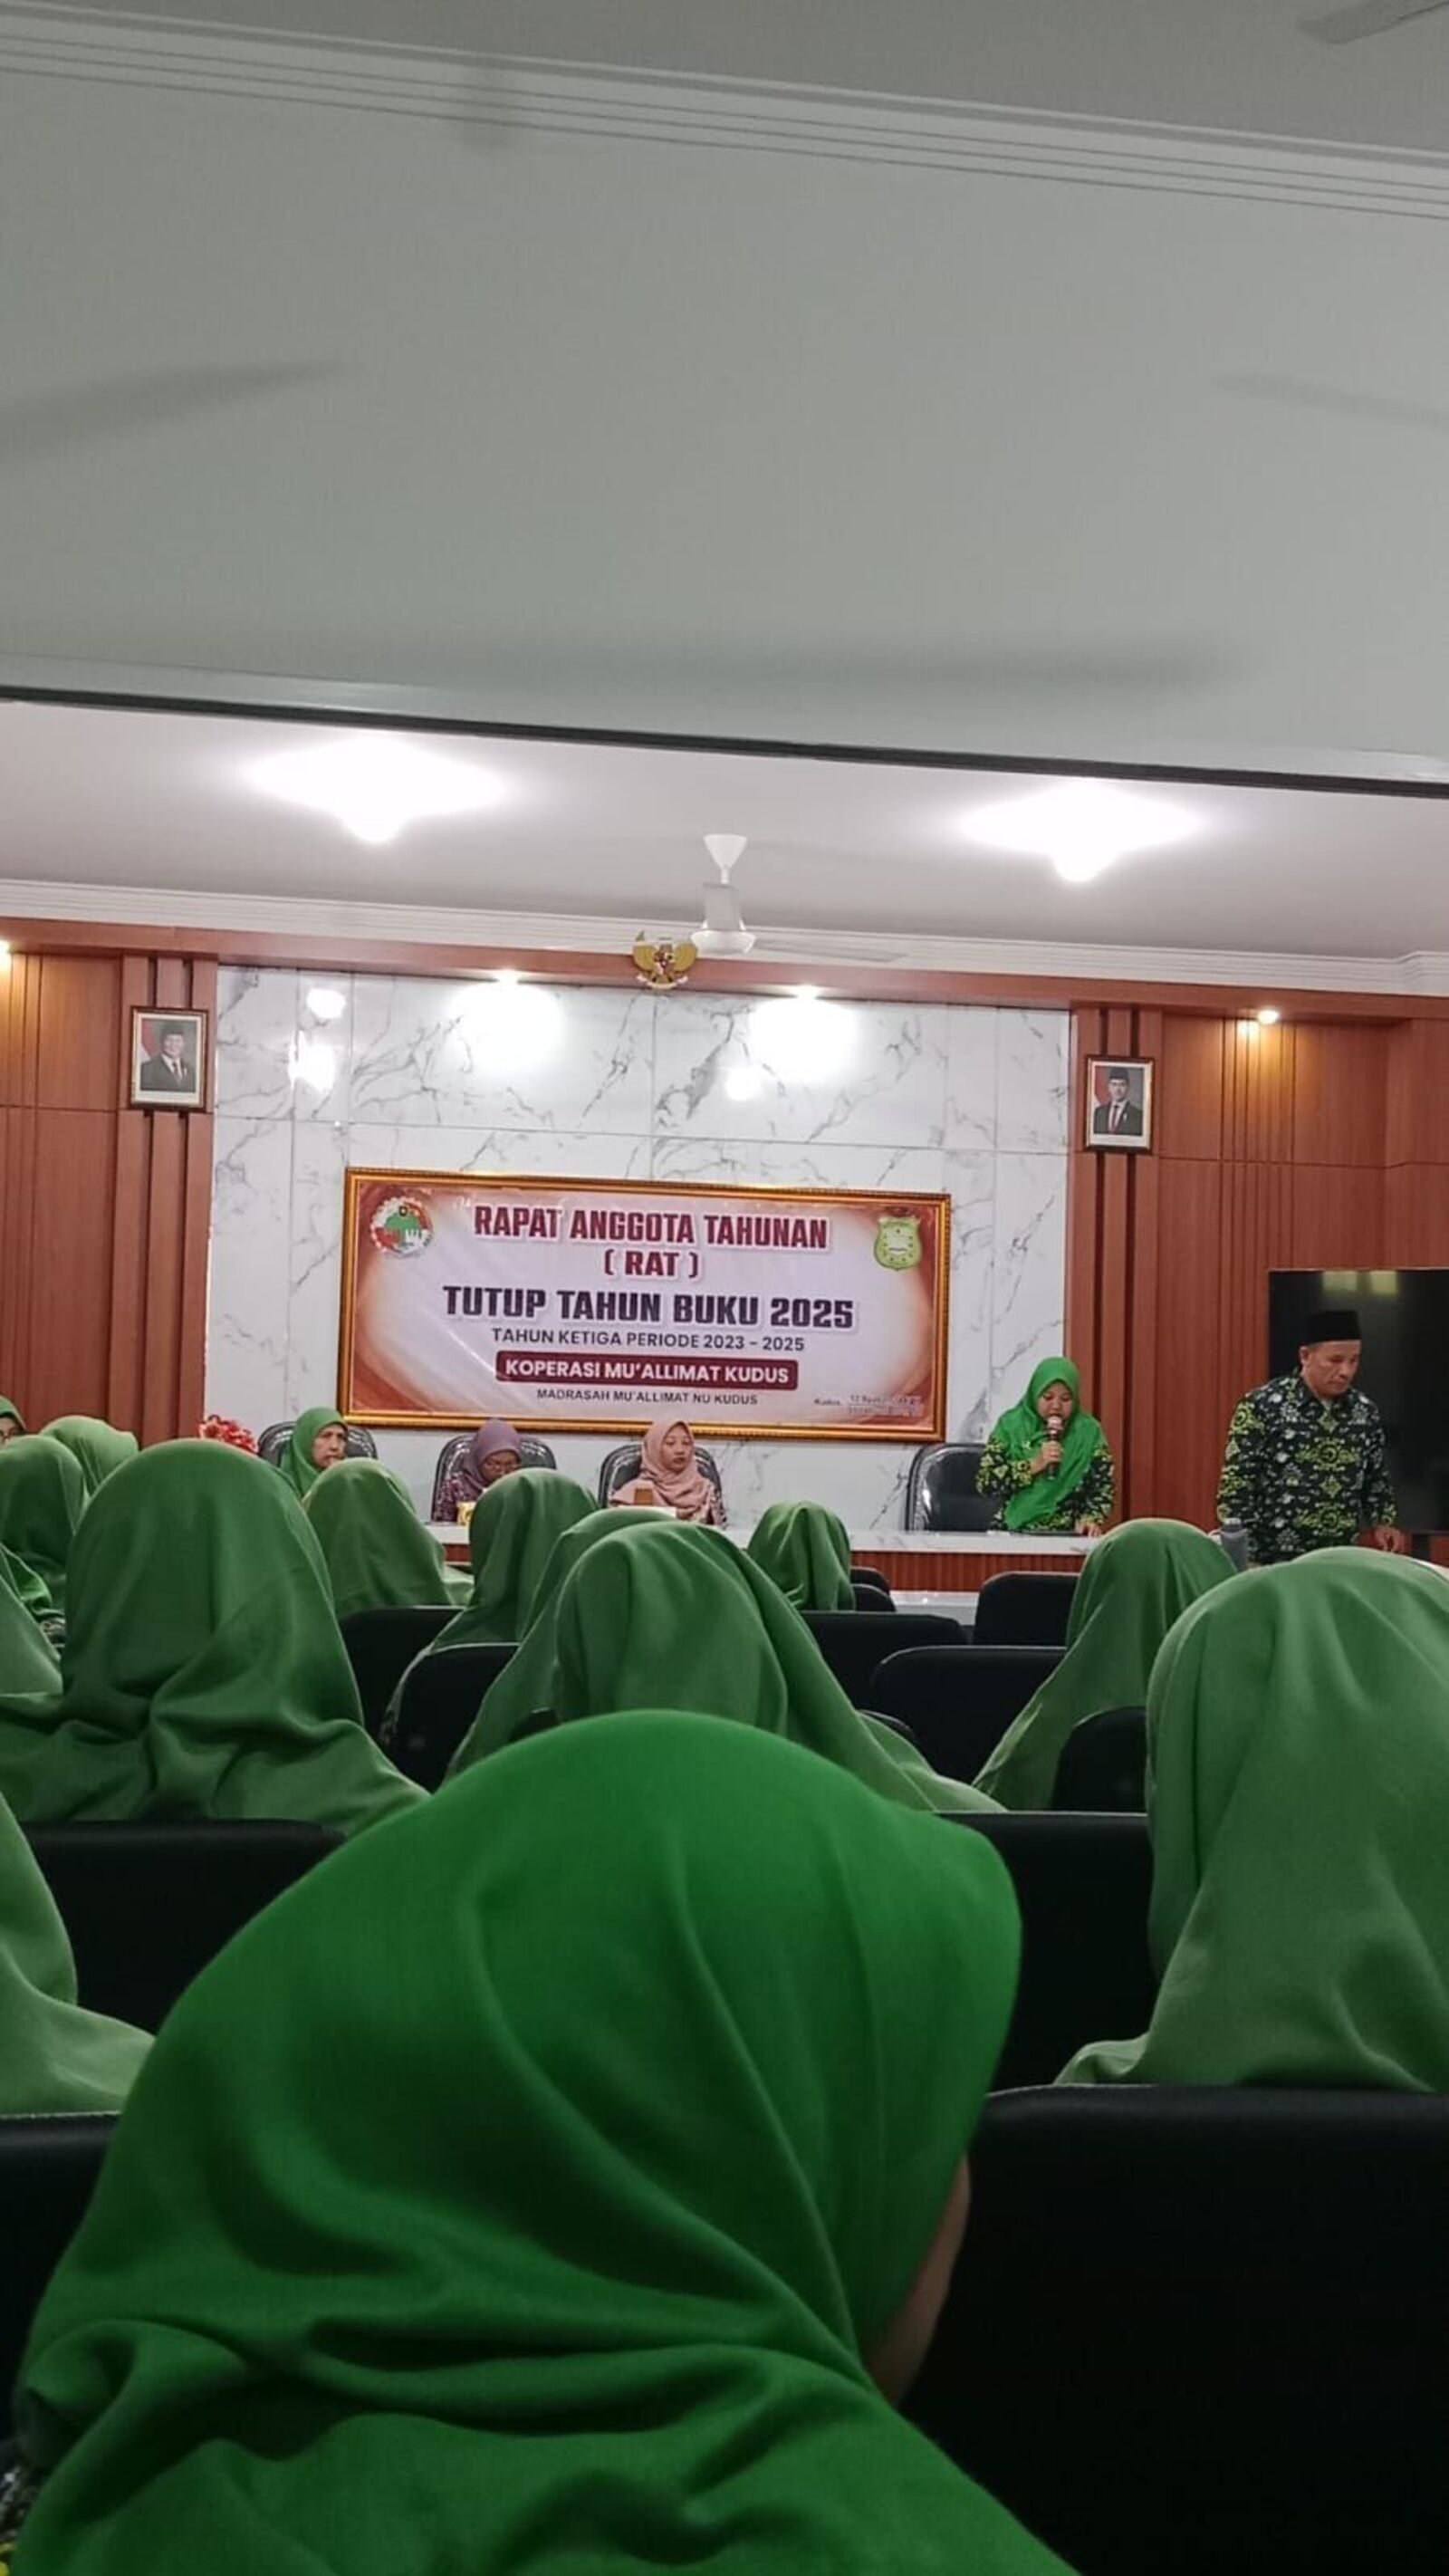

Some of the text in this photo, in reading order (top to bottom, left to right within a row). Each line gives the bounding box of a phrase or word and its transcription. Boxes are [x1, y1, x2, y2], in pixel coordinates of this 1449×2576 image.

[475, 1206, 827, 1249] RAPAT ANGGOTA TAHUNAN
[443, 1285, 853, 1329] TUTUP TAHUN BUKU 2025
[492, 1327, 554, 1343] TAHUN
[558, 1331, 622, 1346] KETIGA
[627, 1333, 698, 1349] PERIODE
[704, 1334, 744, 1350] 2023
[763, 1337, 805, 1351] 2025
[505, 1360, 600, 1379] KOPERASI
[725, 1366, 790, 1384] KUDUS
[537, 1389, 609, 1401] MADRASAH
[693, 1394, 710, 1404] NU
[715, 1395, 758, 1405] KUDUS
